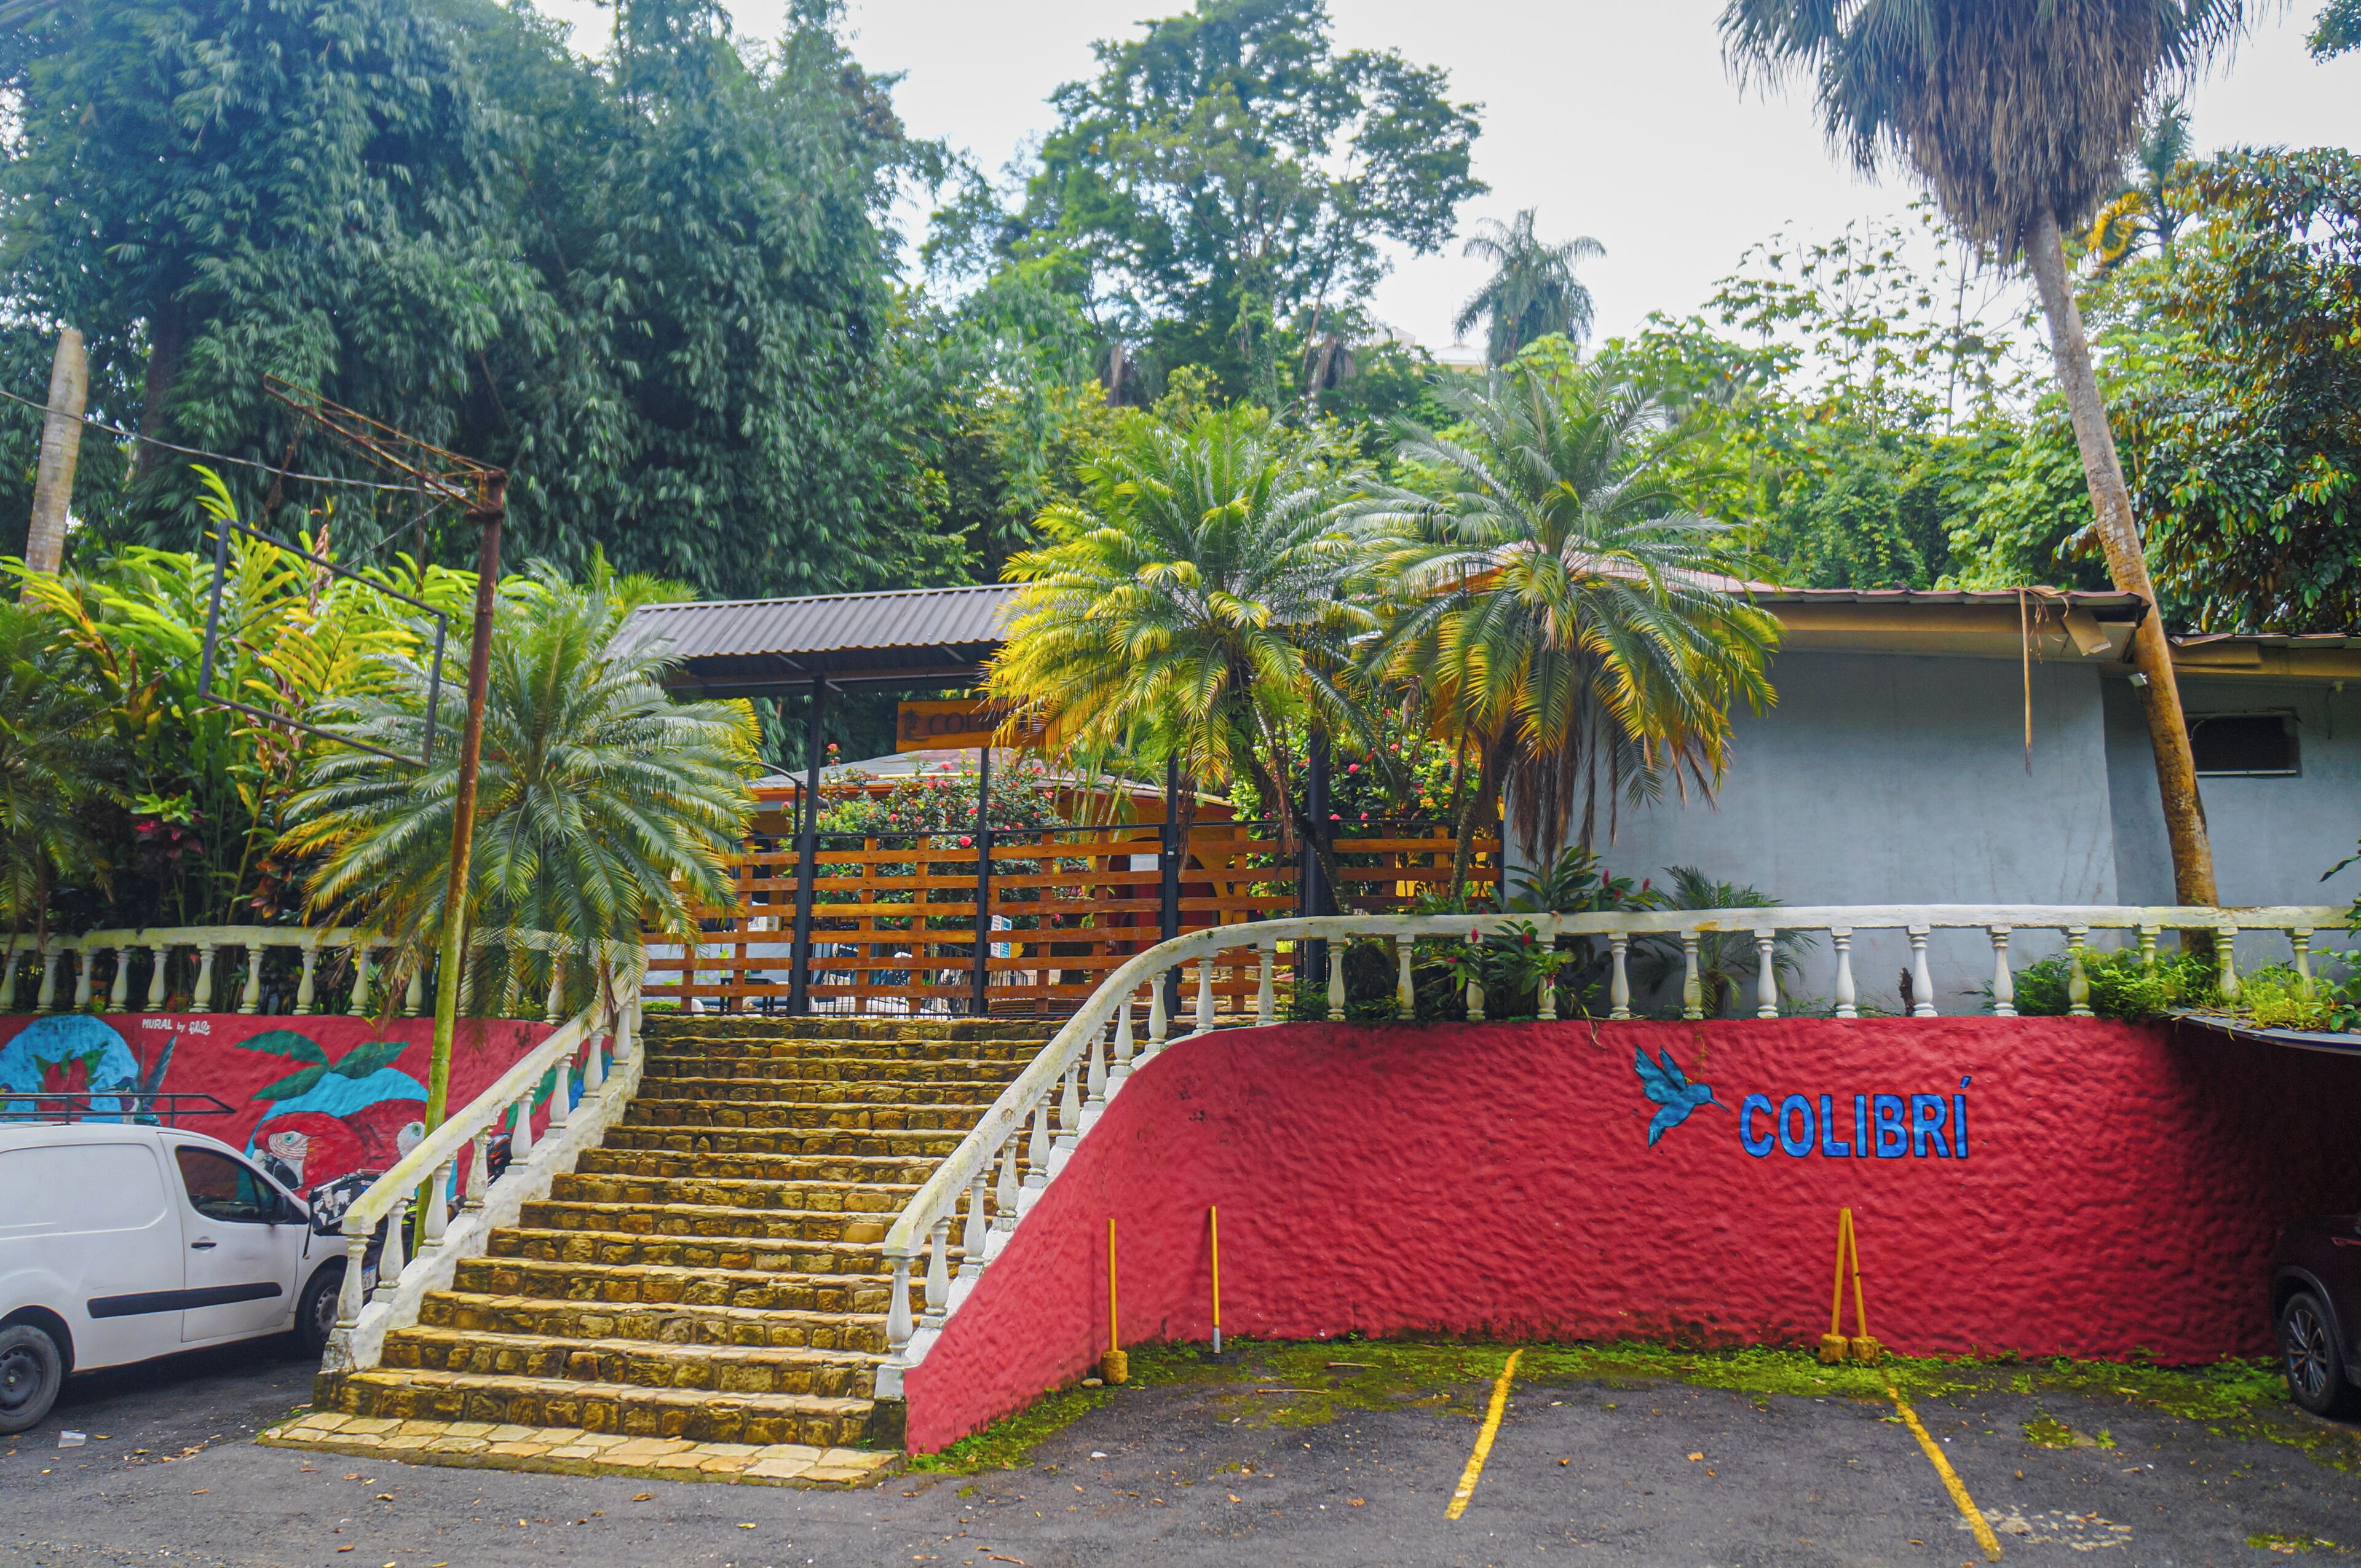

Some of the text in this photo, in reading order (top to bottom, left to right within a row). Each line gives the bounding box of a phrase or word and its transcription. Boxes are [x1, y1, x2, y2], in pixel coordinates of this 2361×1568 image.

[142, 1018, 173, 1030] MURAL
[176, 1022, 186, 1033] by
[1739, 1076, 1971, 1159] COLIBRÍ
